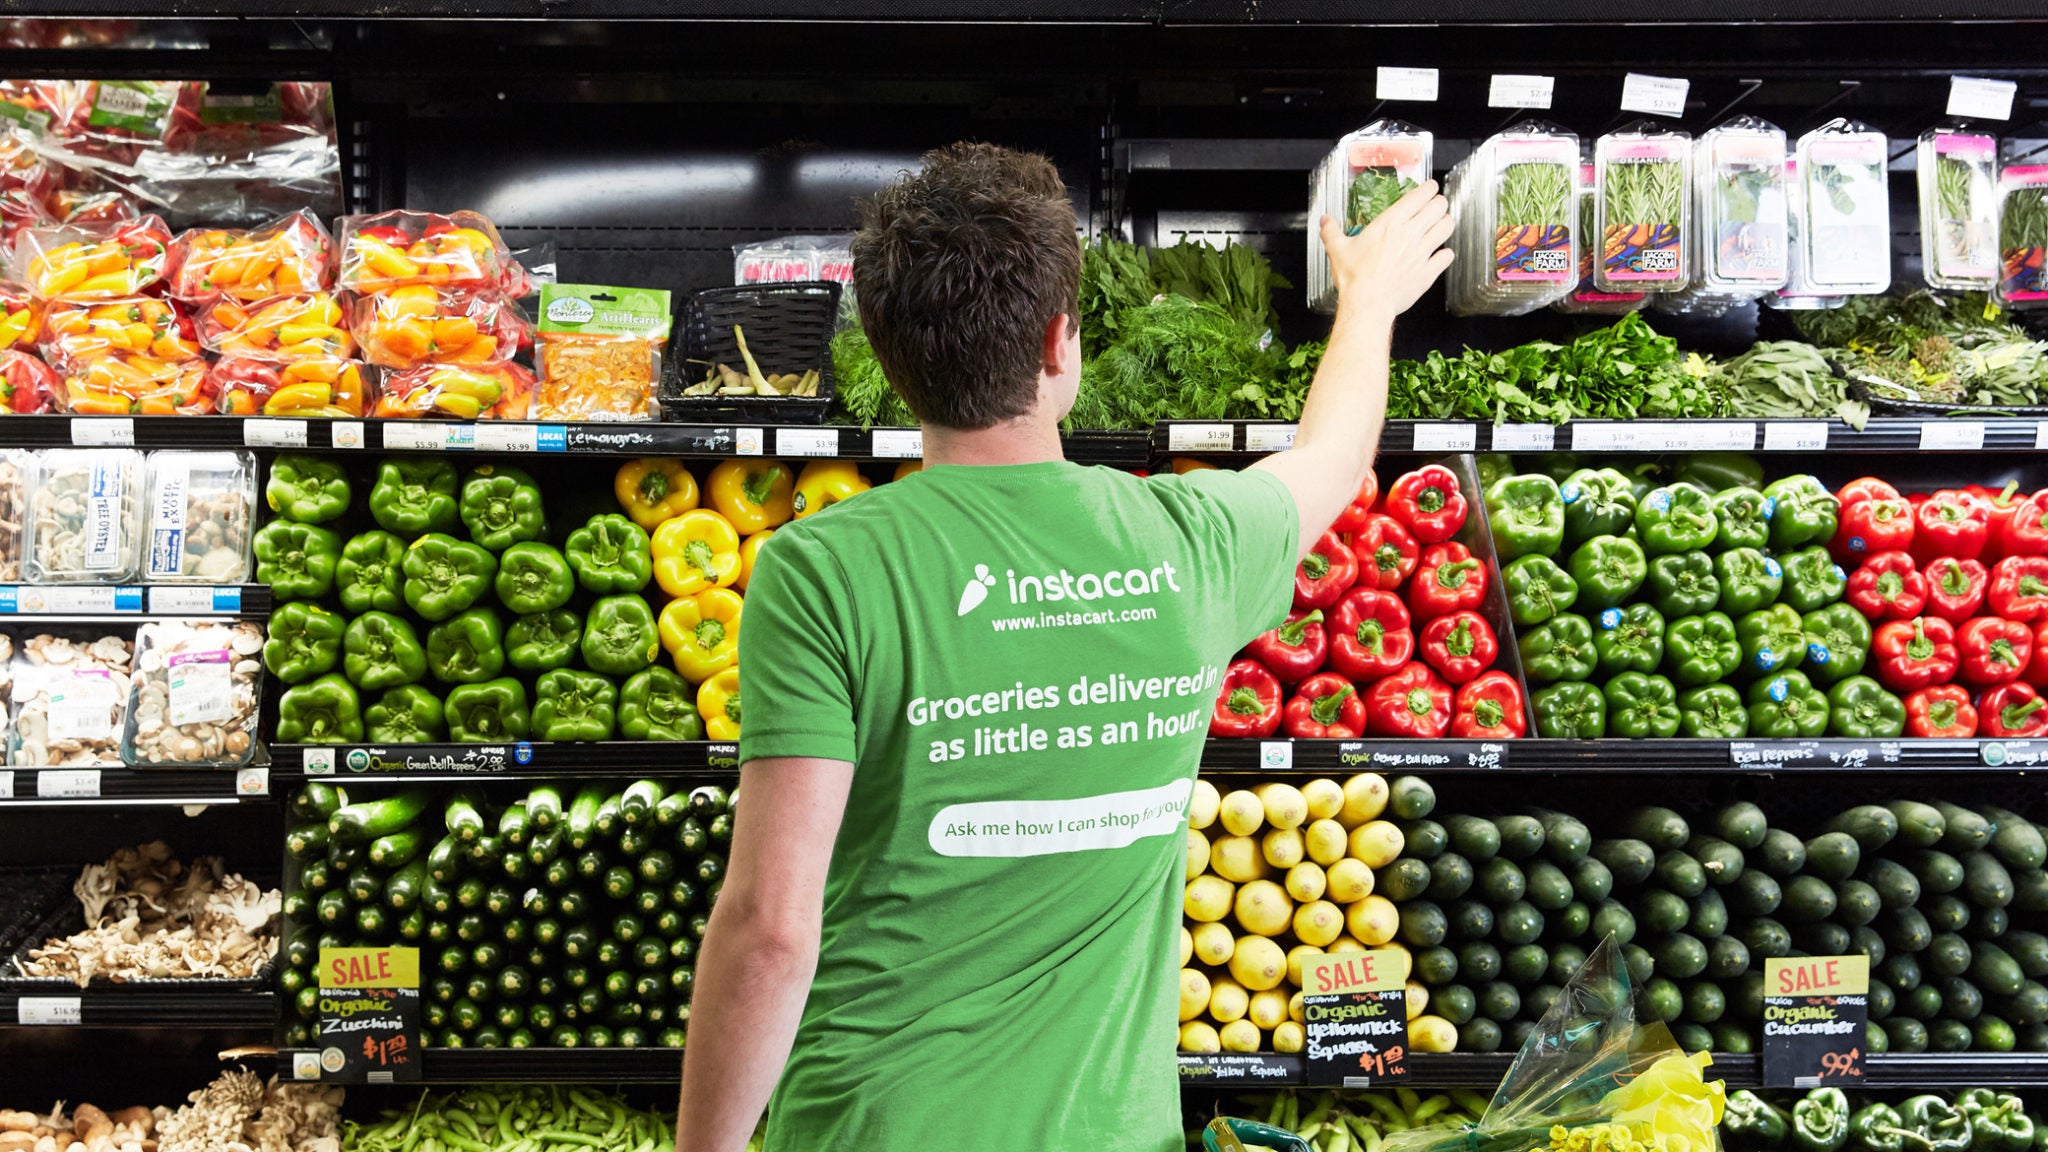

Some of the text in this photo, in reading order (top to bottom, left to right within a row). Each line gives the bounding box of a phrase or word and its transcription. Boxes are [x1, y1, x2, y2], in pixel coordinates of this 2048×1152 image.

[1536, 259, 1566, 269] FARM
[1645, 259, 1676, 269] FARM
[600, 312, 660, 325] ArtiHearts
[538, 432, 564, 441] LOCAL
[1207, 431, 1230, 440] $1.99
[1612, 433, 1634, 441] $1.99
[415, 441, 438, 449] $5.99
[506, 443, 530, 451] $5.99
[816, 440, 838, 448] $3.99
[1447, 441, 1470, 449] $1.99
[1665, 440, 1688, 448] $1.99
[1796, 440, 1820, 448] $1.99
[163, 483, 173, 519] MIXED
[170, 479, 183, 524] EXOTIC
[94, 520, 110, 553] OYSTER
[1006, 561, 1181, 604] instacart
[0, 591, 17, 601] CAL
[116, 588, 142, 596] LOCAL
[214, 588, 241, 596] LOCAL
[992, 607, 1157, 632] www.instacart.com
[906, 664, 1217, 726] Groceries delivered in
[928, 708, 1203, 763] as little as an hour.
[370, 756, 406, 772] Organic
[406, 755, 430, 770] Green
[429, 755, 446, 770] Bell
[446, 755, 476, 772] Peppers
[708, 756, 738, 768] Orga
[1341, 753, 1370, 766] Organic
[1405, 754, 1420, 764] Bell
[1732, 749, 1815, 764] Bell Peppers
[945, 821, 977, 837] Ask
[981, 823, 1011, 836] me
[1015, 820, 1054, 836] how
[1058, 819, 1063, 833] I
[1067, 818, 1096, 833] can
[1099, 811, 1140, 828] shop
[332, 951, 392, 986] SALE
[1315, 956, 1379, 993] SALE
[1778, 960, 1841, 994] SALE
[53, 1007, 81, 1016] $16.99
[320, 999, 393, 1017] Organic
[1305, 1000, 1388, 1023] Organic
[1764, 1005, 1838, 1025] Organic
[322, 1015, 404, 1034] Zucchini
[1764, 1020, 1857, 1036] Cucumber
[1307, 1040, 1379, 1062] Squash
[1208, 1055, 1219, 1064] in
[1179, 1065, 1288, 1079] Organic Yellow Squash
